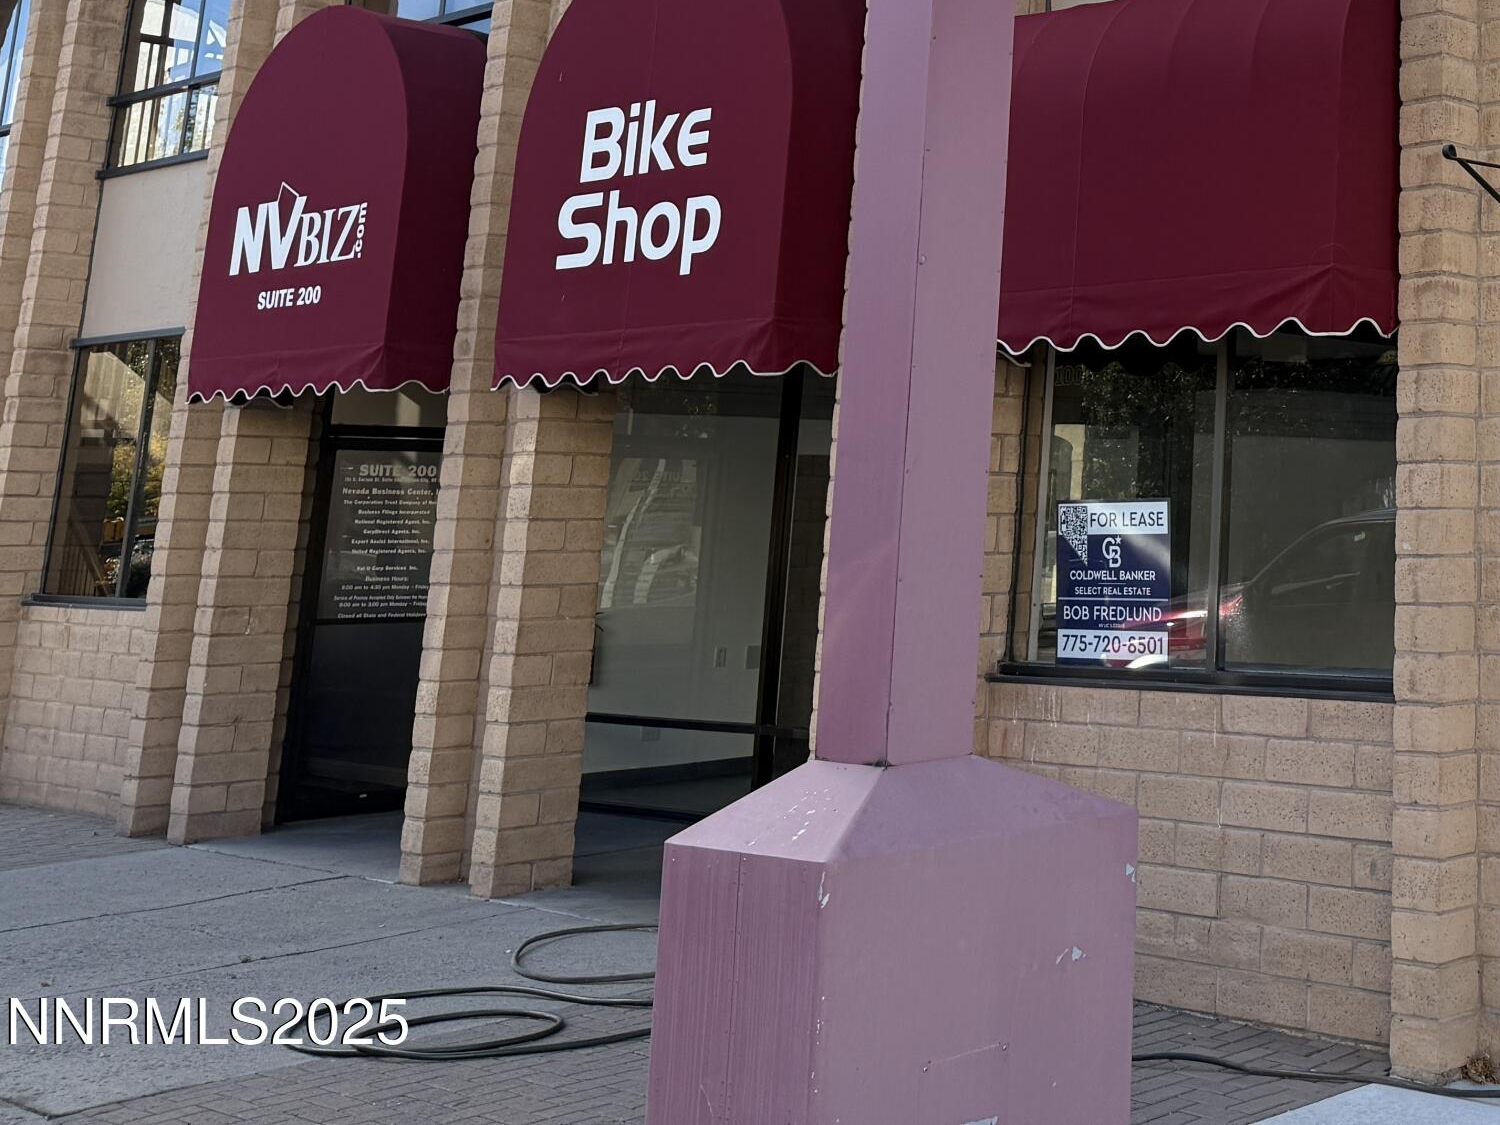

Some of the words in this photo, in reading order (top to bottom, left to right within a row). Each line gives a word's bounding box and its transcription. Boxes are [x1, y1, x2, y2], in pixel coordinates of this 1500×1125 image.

[579, 99, 713, 183] Bike
[555, 190, 722, 276] Shop
[257, 288, 295, 311] SUITE
[296, 285, 322, 306] 200
[359, 464, 401, 477] SUITE
[408, 465, 437, 477] 200
[342, 487, 370, 495] Nevada
[407, 487, 434, 496] Center,
[1090, 512, 1117, 527] FOR
[1122, 511, 1164, 527] LEASE
[1069, 570, 1117, 581] COLDWELL
[1120, 570, 1156, 581] BANKER
[1074, 586, 1101, 596] SELECT
[1103, 587, 1122, 595] REAL
[1124, 587, 1152, 596] ESTATE
[1063, 605, 1090, 621] BOB
[1094, 605, 1162, 622] FREDLUND
